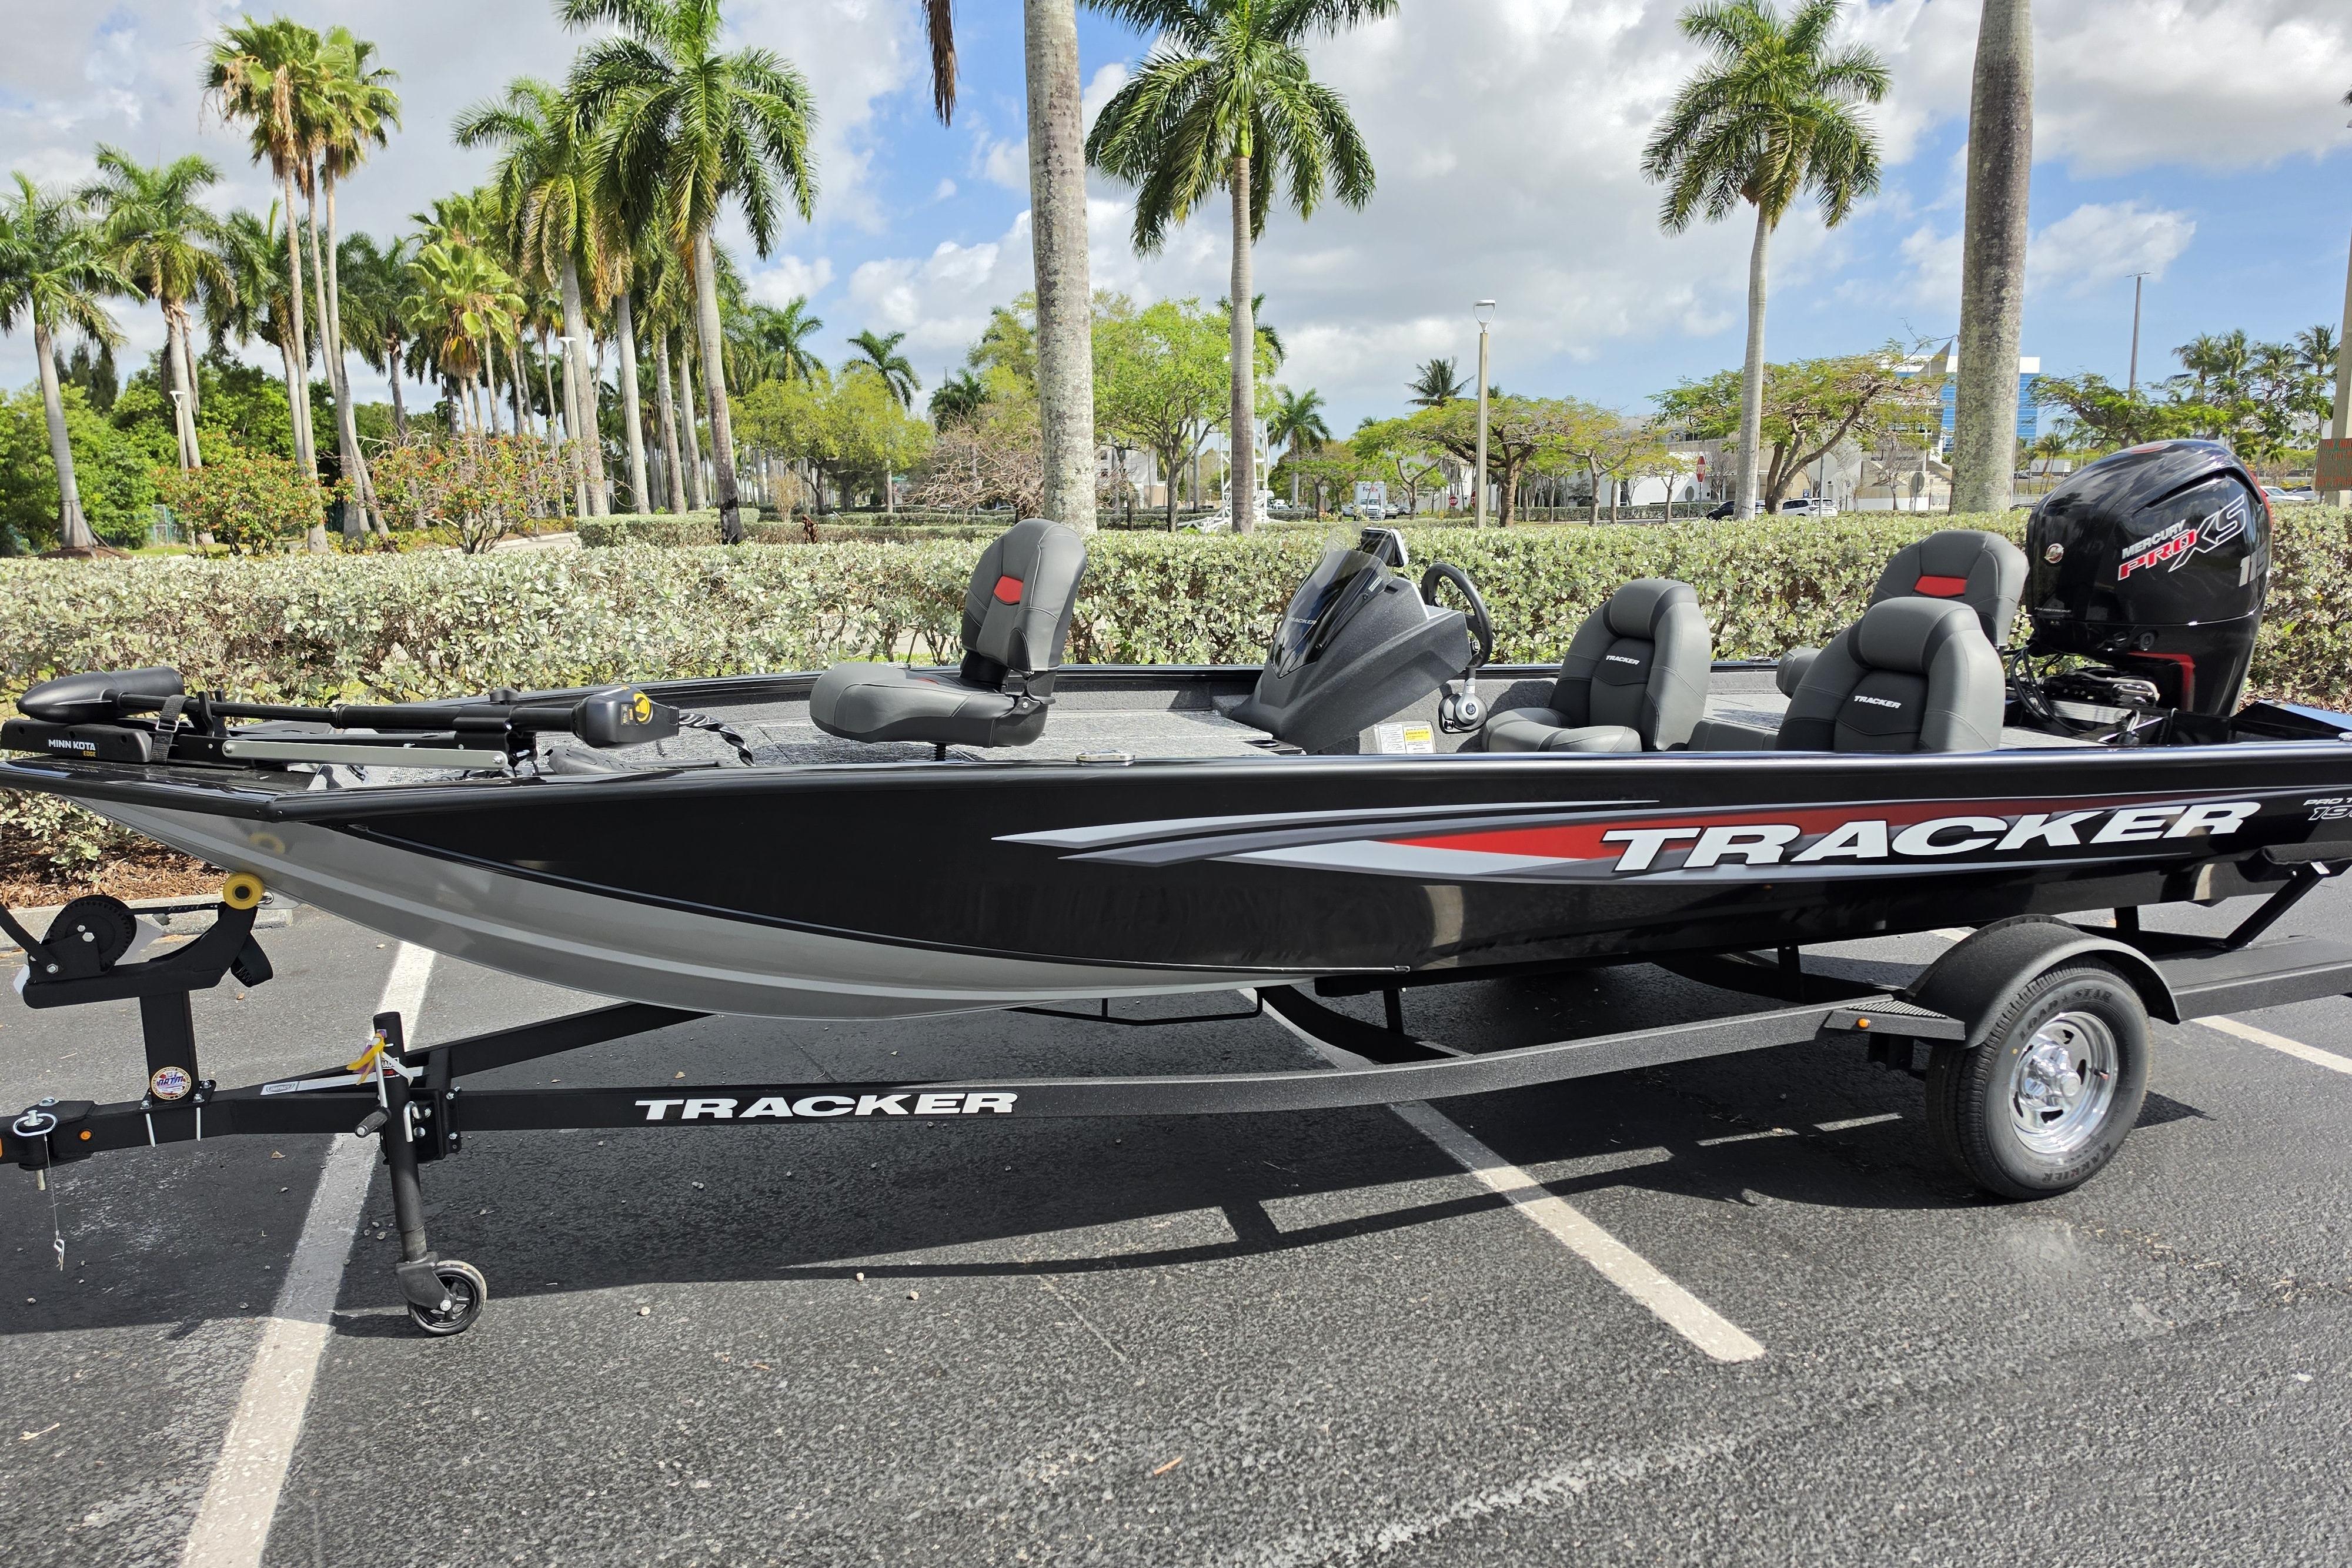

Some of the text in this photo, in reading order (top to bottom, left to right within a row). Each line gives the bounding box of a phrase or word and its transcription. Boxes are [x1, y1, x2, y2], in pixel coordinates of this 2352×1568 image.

[2118, 493, 2246, 581] PRO XS
[2122, 519, 2186, 559] MERCURY
[2239, 540, 2267, 587] 115
[1606, 655, 1641, 665] TRACKER
[1854, 696, 1902, 708] TRACKER
[48, 739, 96, 751] MINN KOTA
[2307, 804, 2352, 821] 19
[1603, 802, 2260, 871] TRACKER
[2019, 988, 2113, 1041] LOAD STAR
[635, 1092, 1018, 1121] TRACKER
